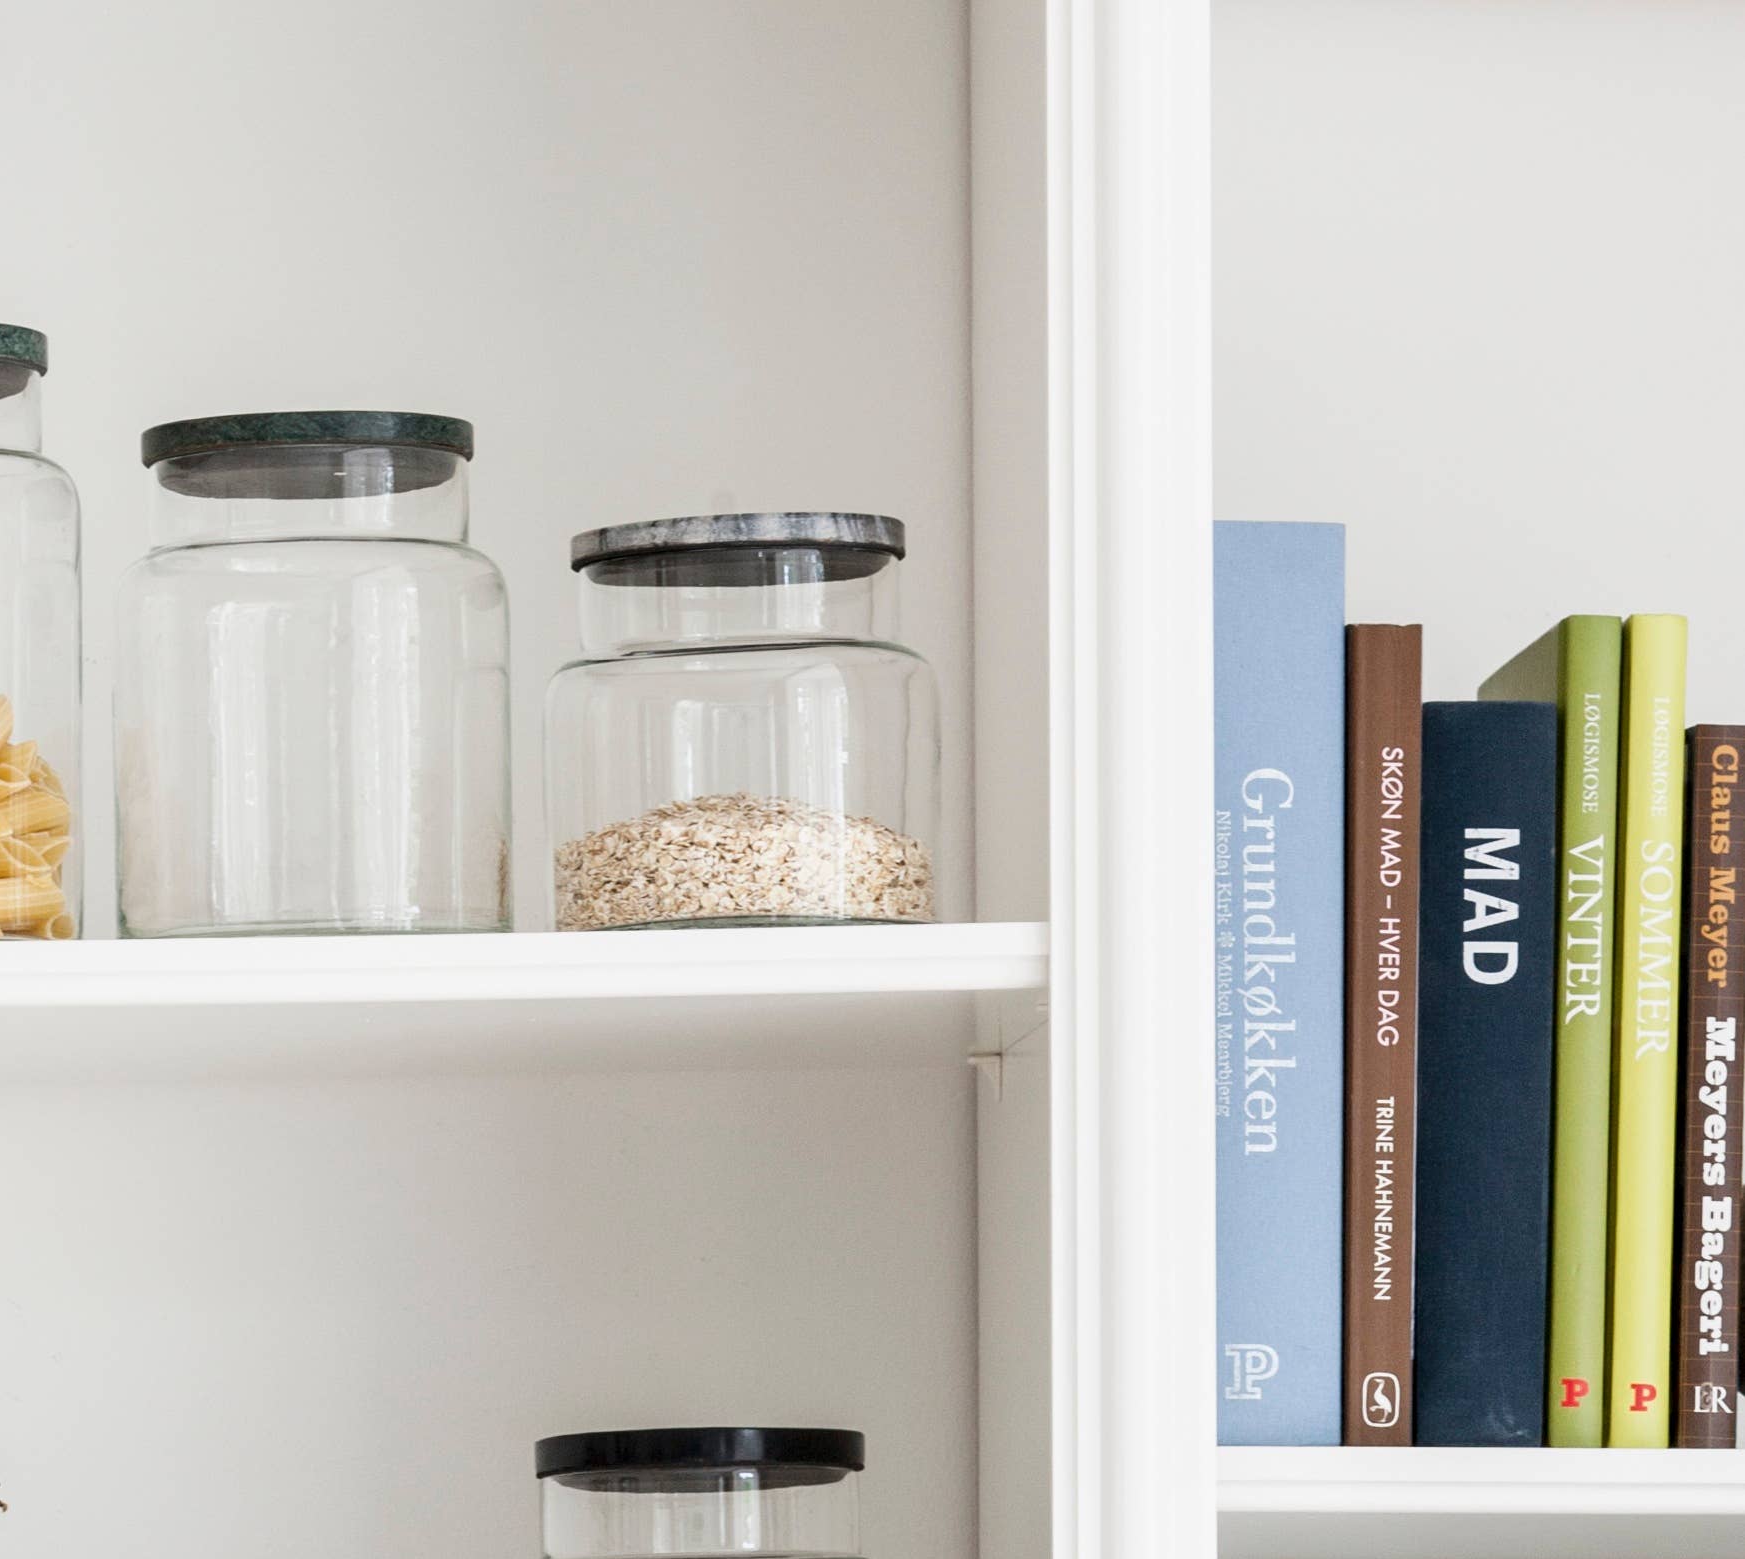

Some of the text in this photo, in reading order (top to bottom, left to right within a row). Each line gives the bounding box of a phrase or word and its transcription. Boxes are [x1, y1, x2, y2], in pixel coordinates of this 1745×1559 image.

[1380, 746, 1404, 820] SKØN
[1581, 692, 1602, 814] LØGISMOSE
[1650, 697, 1671, 818] LØGISMOSE
[1215, 881, 1233, 925] Kirk
[1379, 827, 1402, 888] MAD
[1462, 827, 1521, 986] MAD
[1700, 744, 1739, 989] Claus Meyer
[1215, 954, 1234, 1017] Mikkel
[1239, 768, 1296, 1155] Grundkøkken
[1378, 917, 1401, 982] HVER
[1564, 834, 1605, 1026] VINTER
[1634, 838, 1676, 1061] SOMMER
[1376, 989, 1401, 1048] DAG
[1372, 1096, 1395, 1301] TRINE HAHNEMANN
[1693, 1015, 1737, 1357] Meyers Bageri
[1561, 1378, 1589, 1408] P
[1629, 1384, 1658, 1412] P
